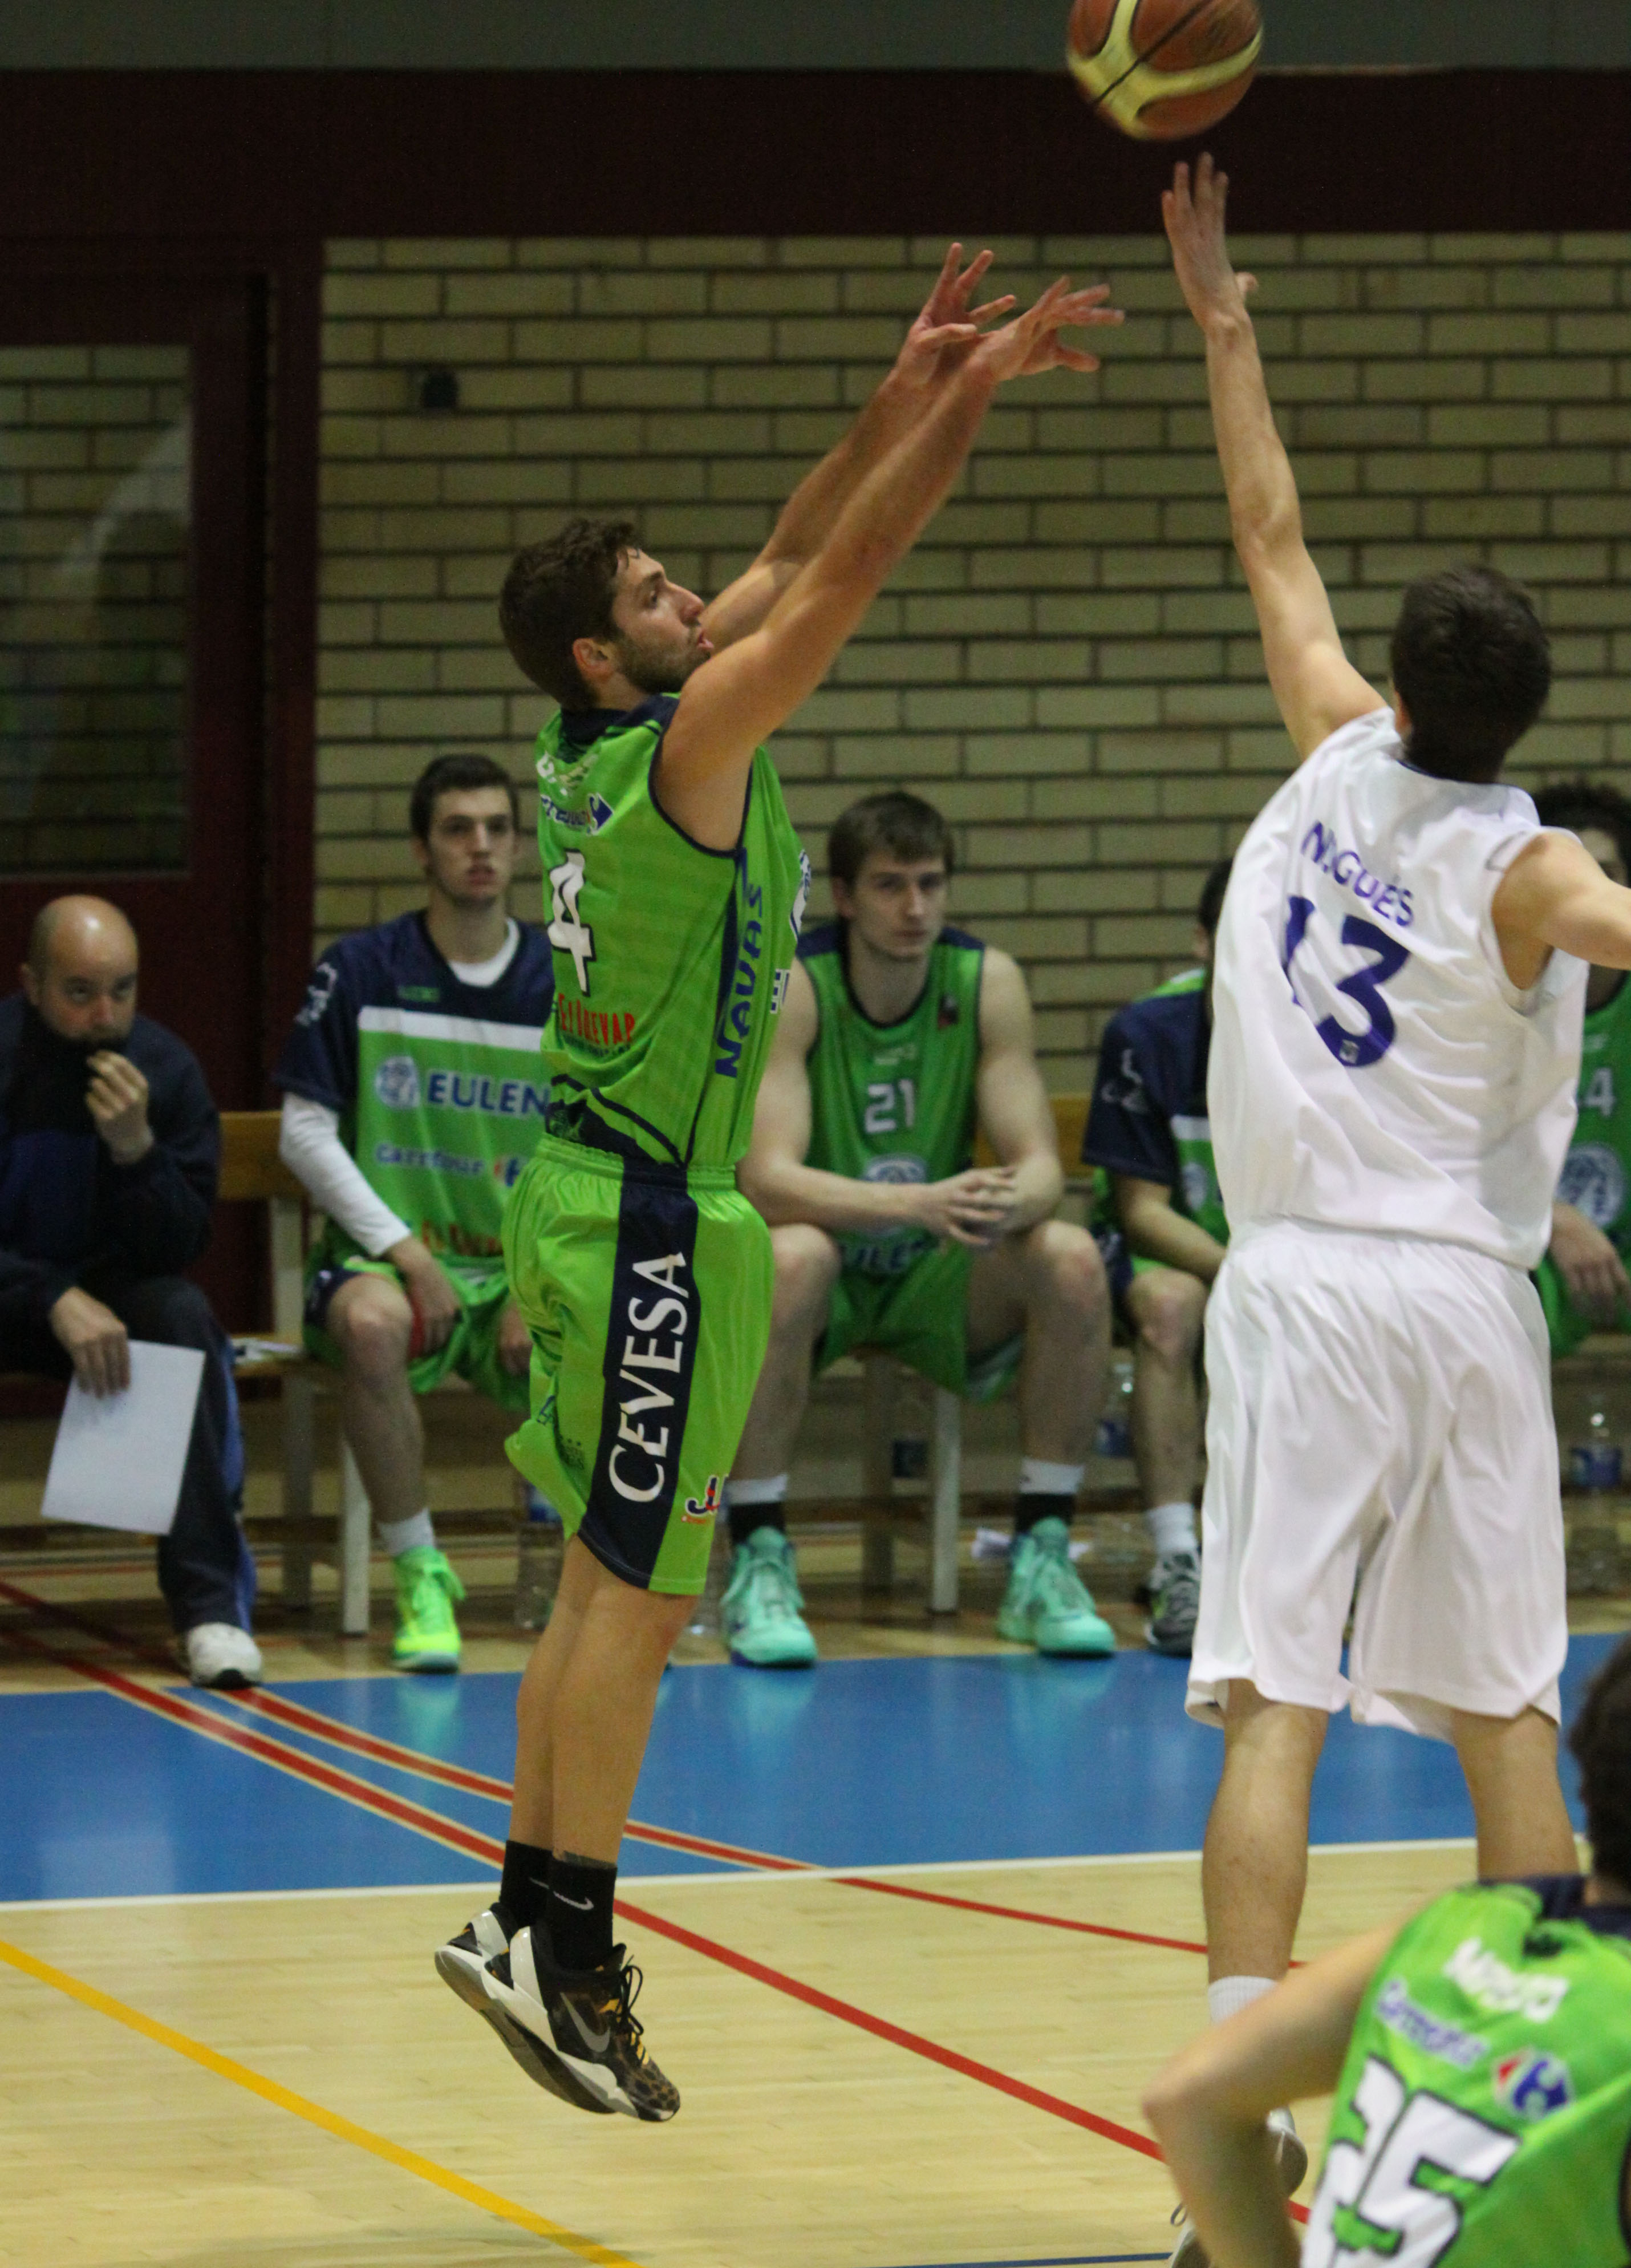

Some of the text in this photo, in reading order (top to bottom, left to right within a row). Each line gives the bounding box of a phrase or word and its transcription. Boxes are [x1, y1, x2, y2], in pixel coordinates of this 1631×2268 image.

[546, 848, 597, 997] 4
[1284, 894, 1412, 1067] 13
[429, 1071, 551, 1117] EULEN
[864, 1079, 917, 1135] 21
[608, 1251, 689, 1502] CEVESA
